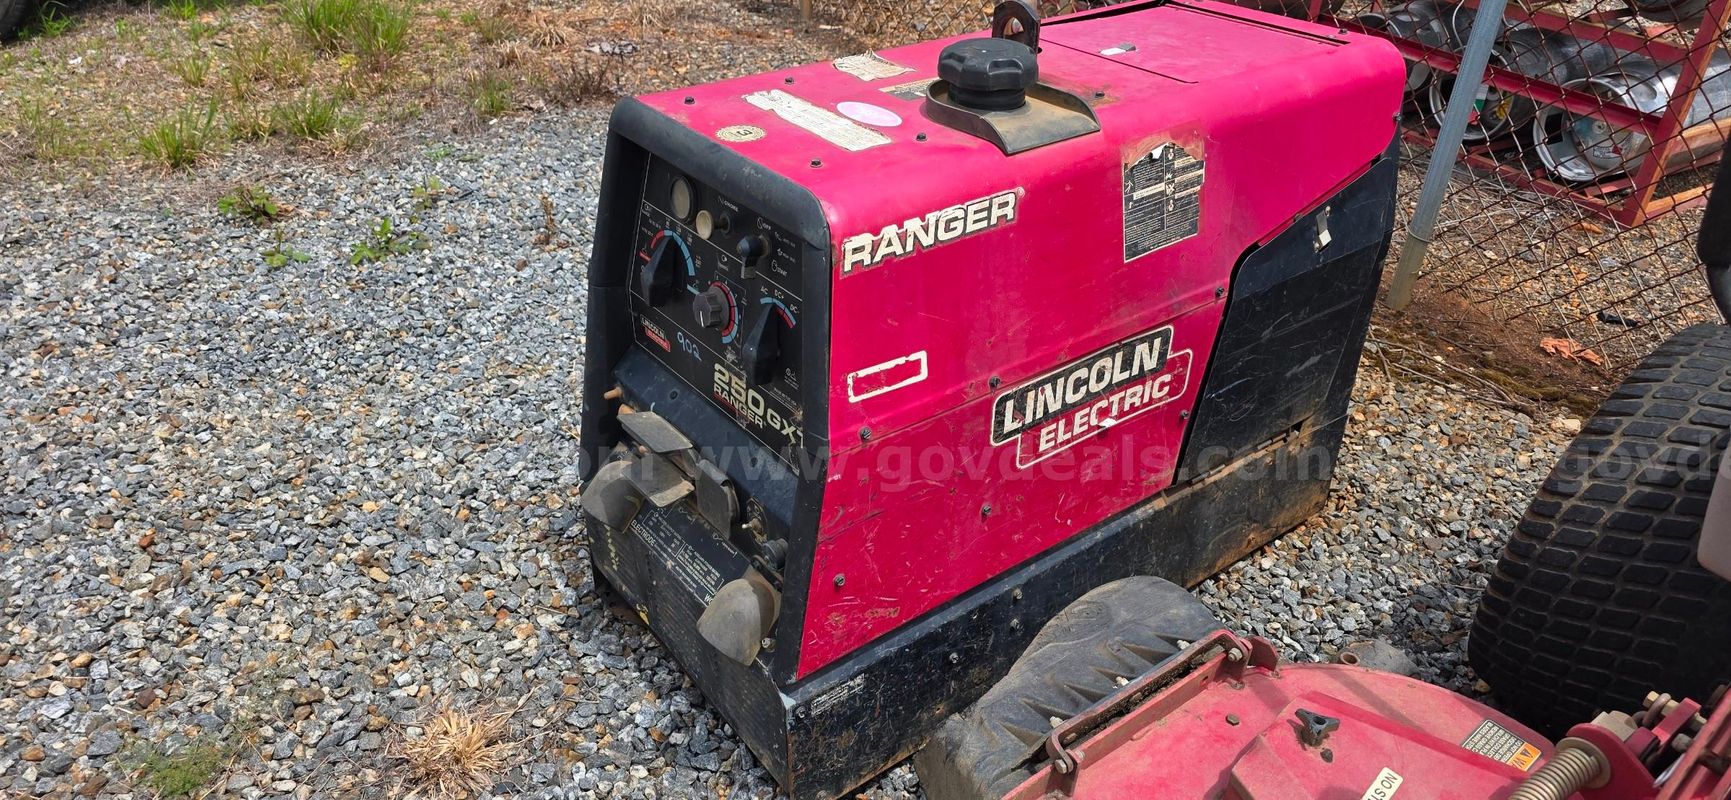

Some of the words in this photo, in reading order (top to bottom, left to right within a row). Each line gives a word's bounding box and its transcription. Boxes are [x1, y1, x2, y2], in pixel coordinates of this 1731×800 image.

[842, 192, 1016, 272] RANGER
[760, 285, 769, 295] AC
[677, 331, 702, 361] 902
[713, 383, 763, 429] RANGER
[714, 363, 765, 417] 250
[1003, 337, 1161, 434] LINCOLN
[1039, 374, 1171, 452] ELECTRIC
[631, 520, 656, 546] ELECTRODE
